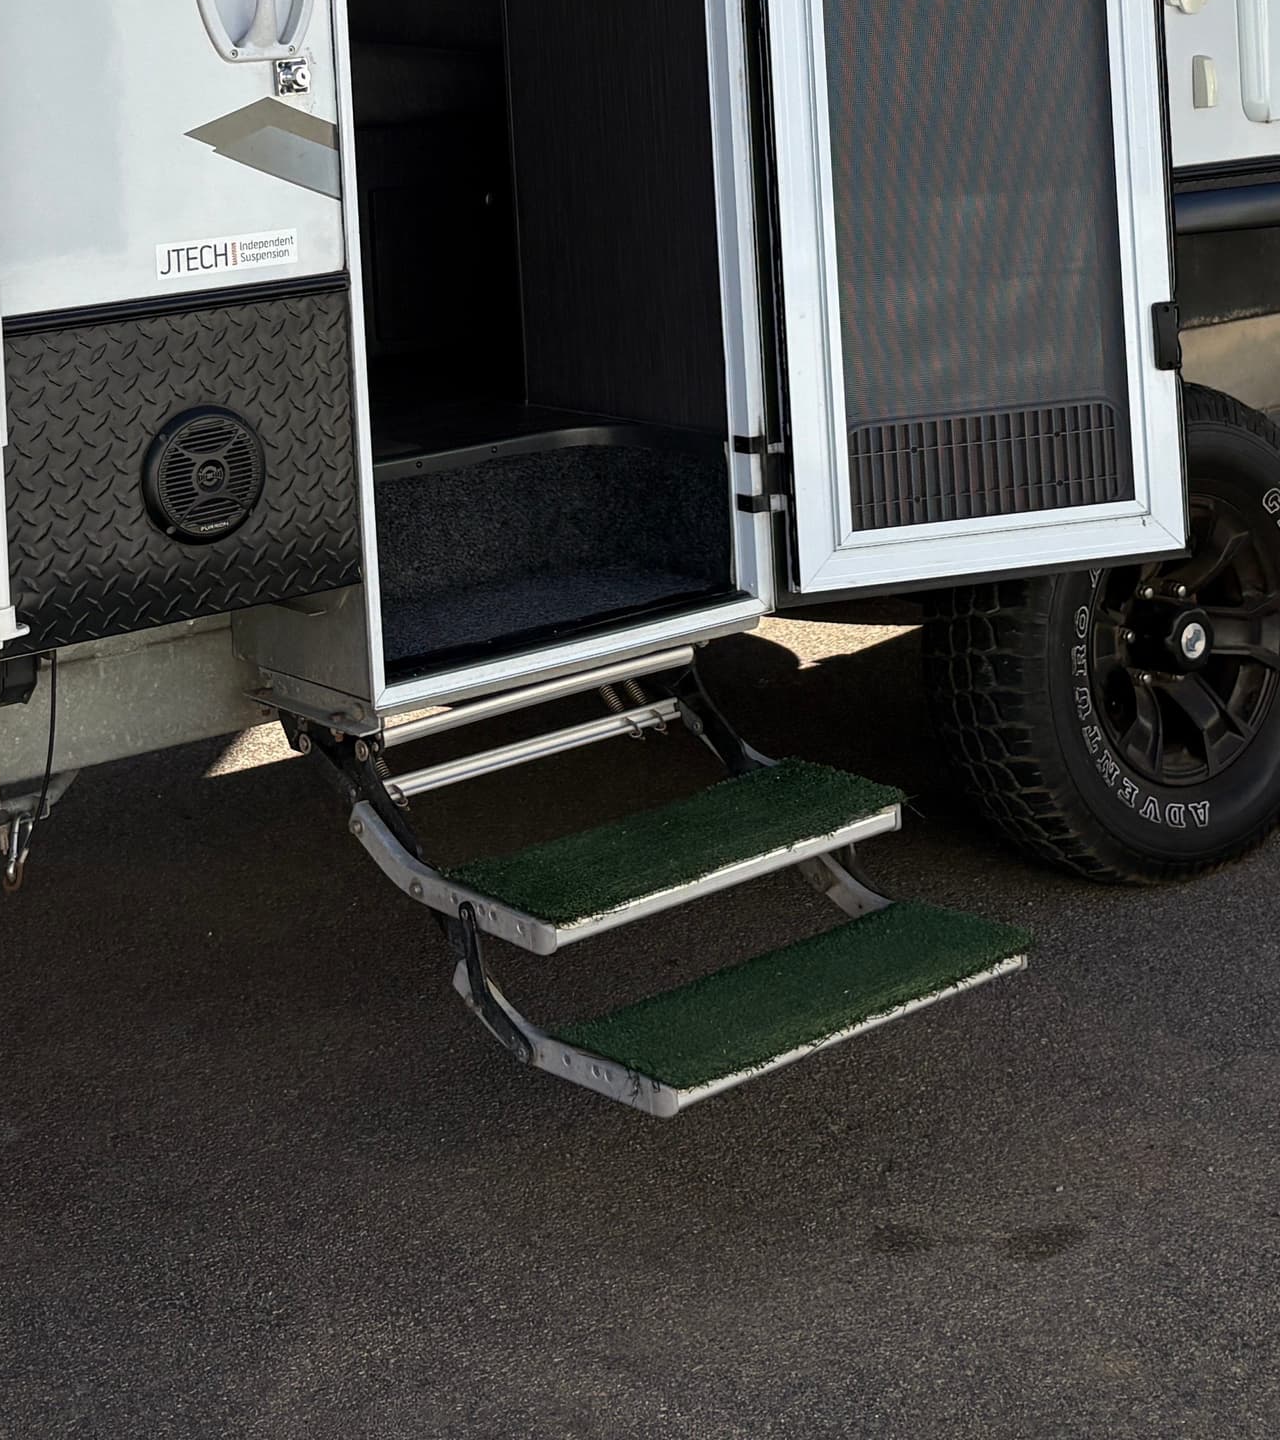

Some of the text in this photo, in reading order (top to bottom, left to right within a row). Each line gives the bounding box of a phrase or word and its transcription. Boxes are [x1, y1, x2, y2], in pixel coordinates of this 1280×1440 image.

[239, 236, 294, 251] Independent
[240, 248, 290, 263] Suspension
[160, 242, 228, 275] JTECH
[1071, 606, 1210, 827] ADVENTURO
